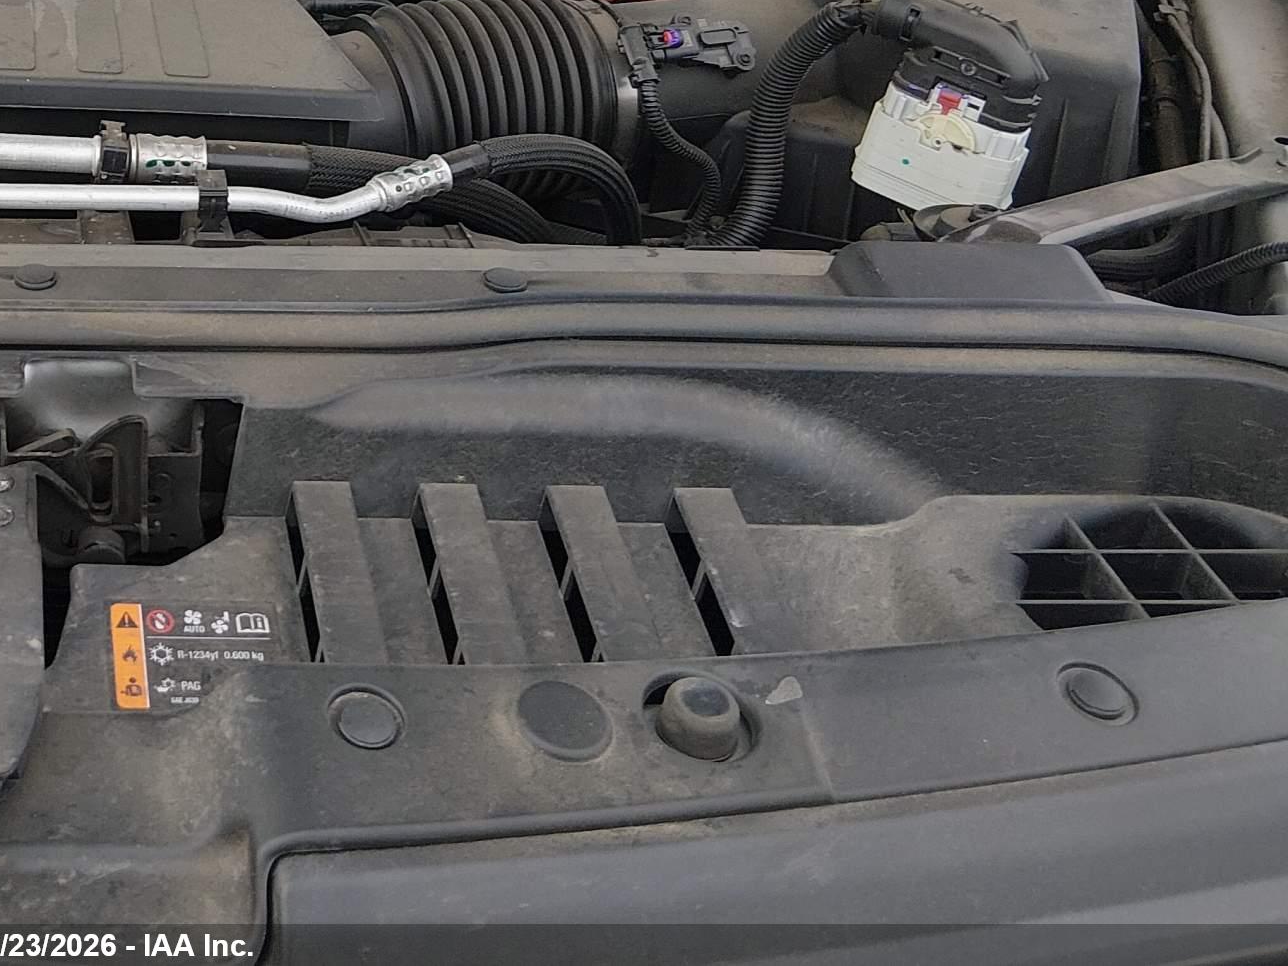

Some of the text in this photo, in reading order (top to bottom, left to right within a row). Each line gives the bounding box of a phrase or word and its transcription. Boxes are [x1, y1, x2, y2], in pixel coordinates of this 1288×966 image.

[183, 624, 206, 634] AUTO
[176, 649, 264, 662] R-1234yf 0.600 kg
[181, 680, 201, 692] PAG
